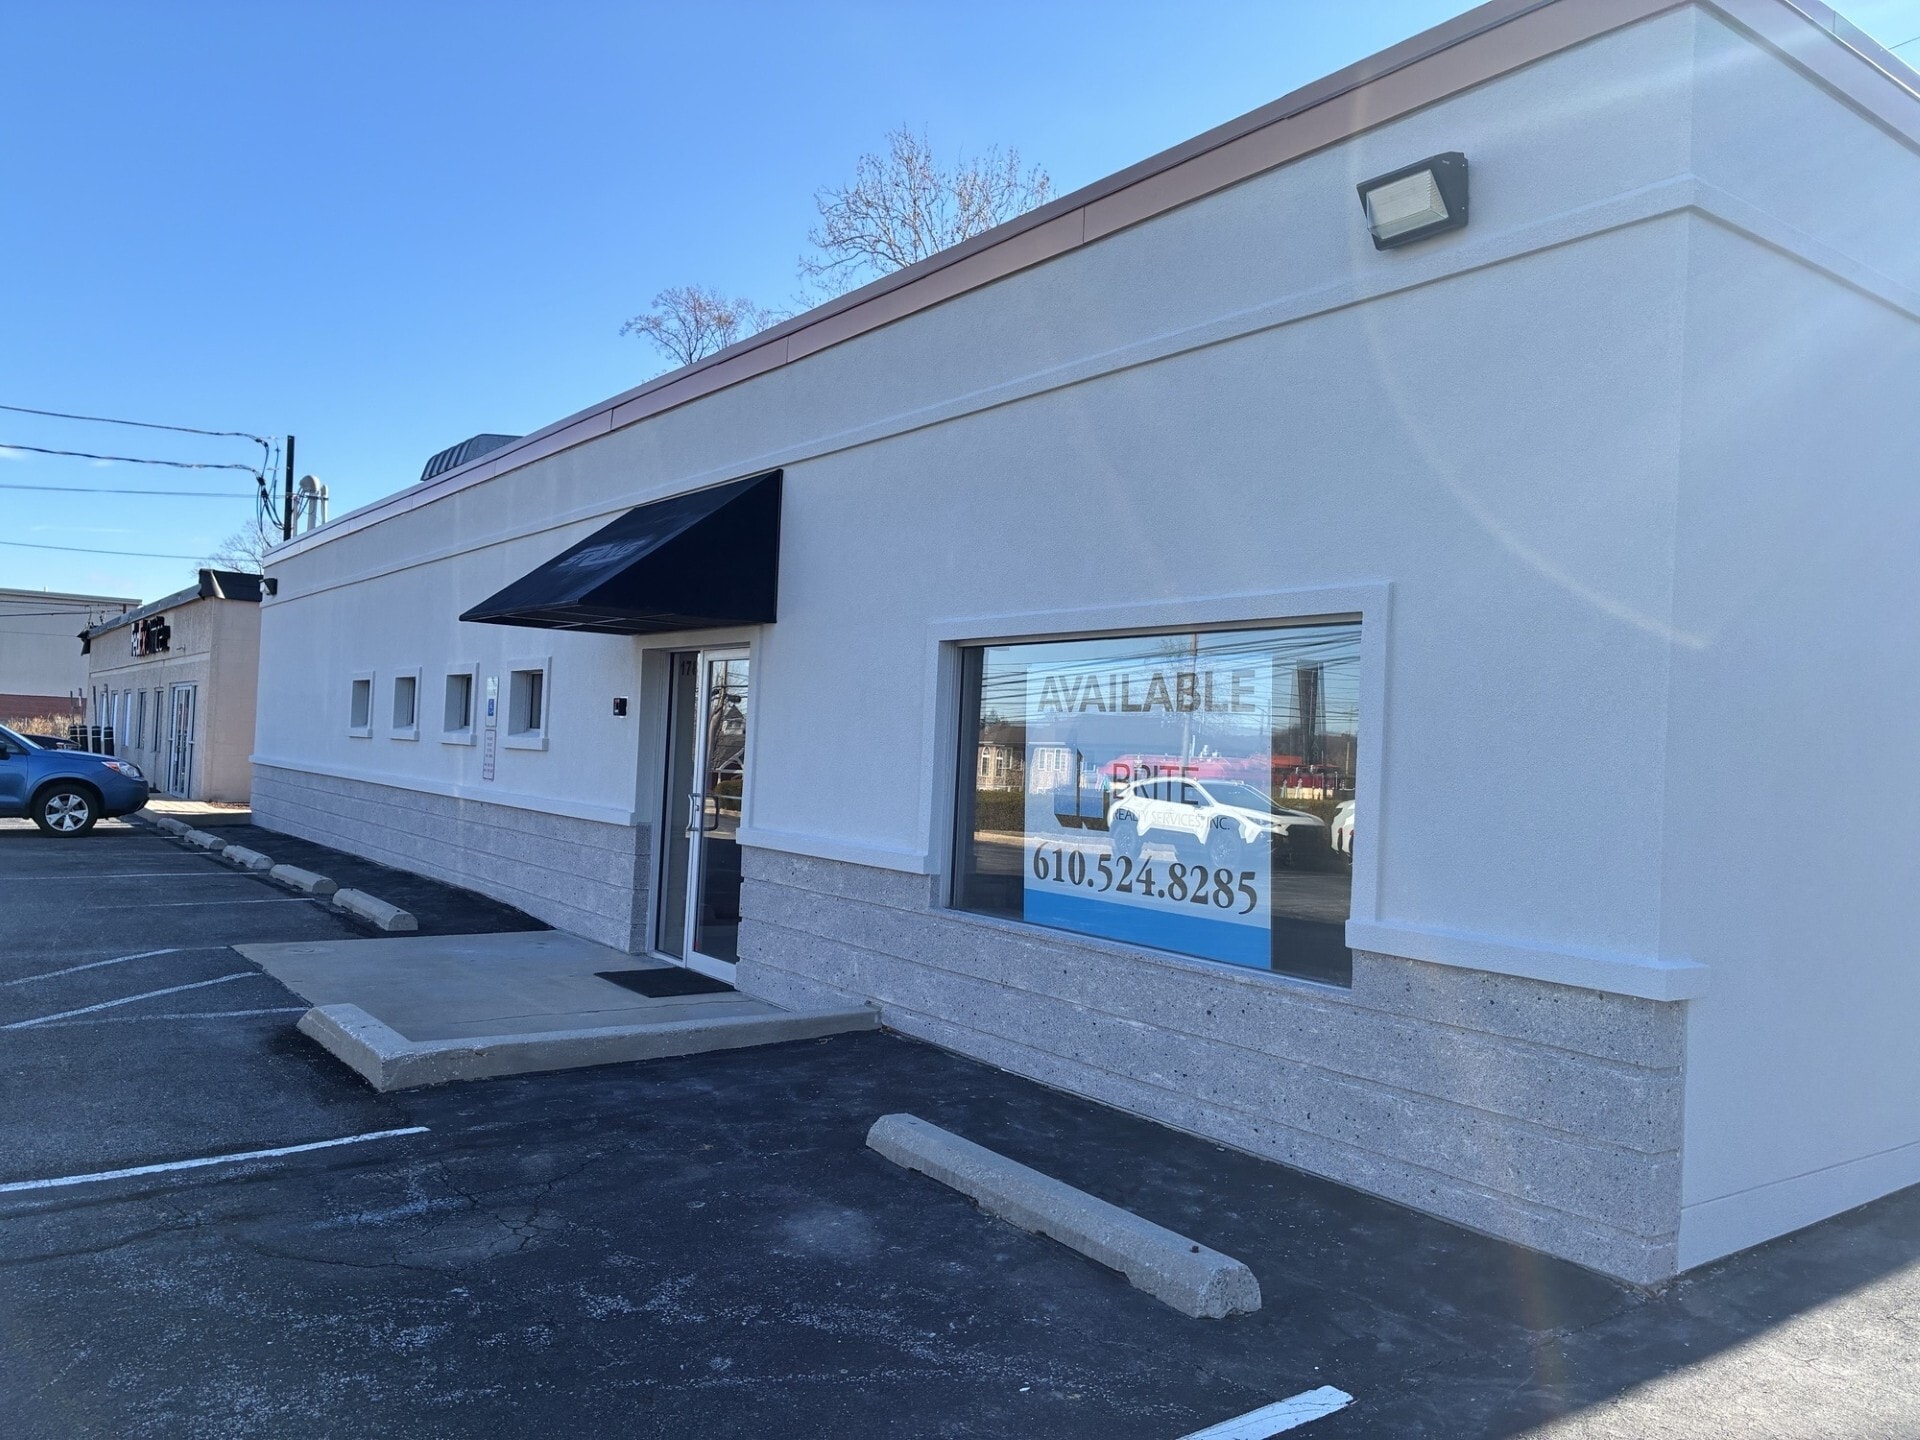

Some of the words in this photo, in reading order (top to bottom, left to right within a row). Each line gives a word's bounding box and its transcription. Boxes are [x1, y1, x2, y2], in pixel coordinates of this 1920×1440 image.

[1038, 670, 1256, 713] AVAILABLE
[1113, 763, 1199, 805] BRITE
[1033, 841, 1258, 915] 610.524.8285
